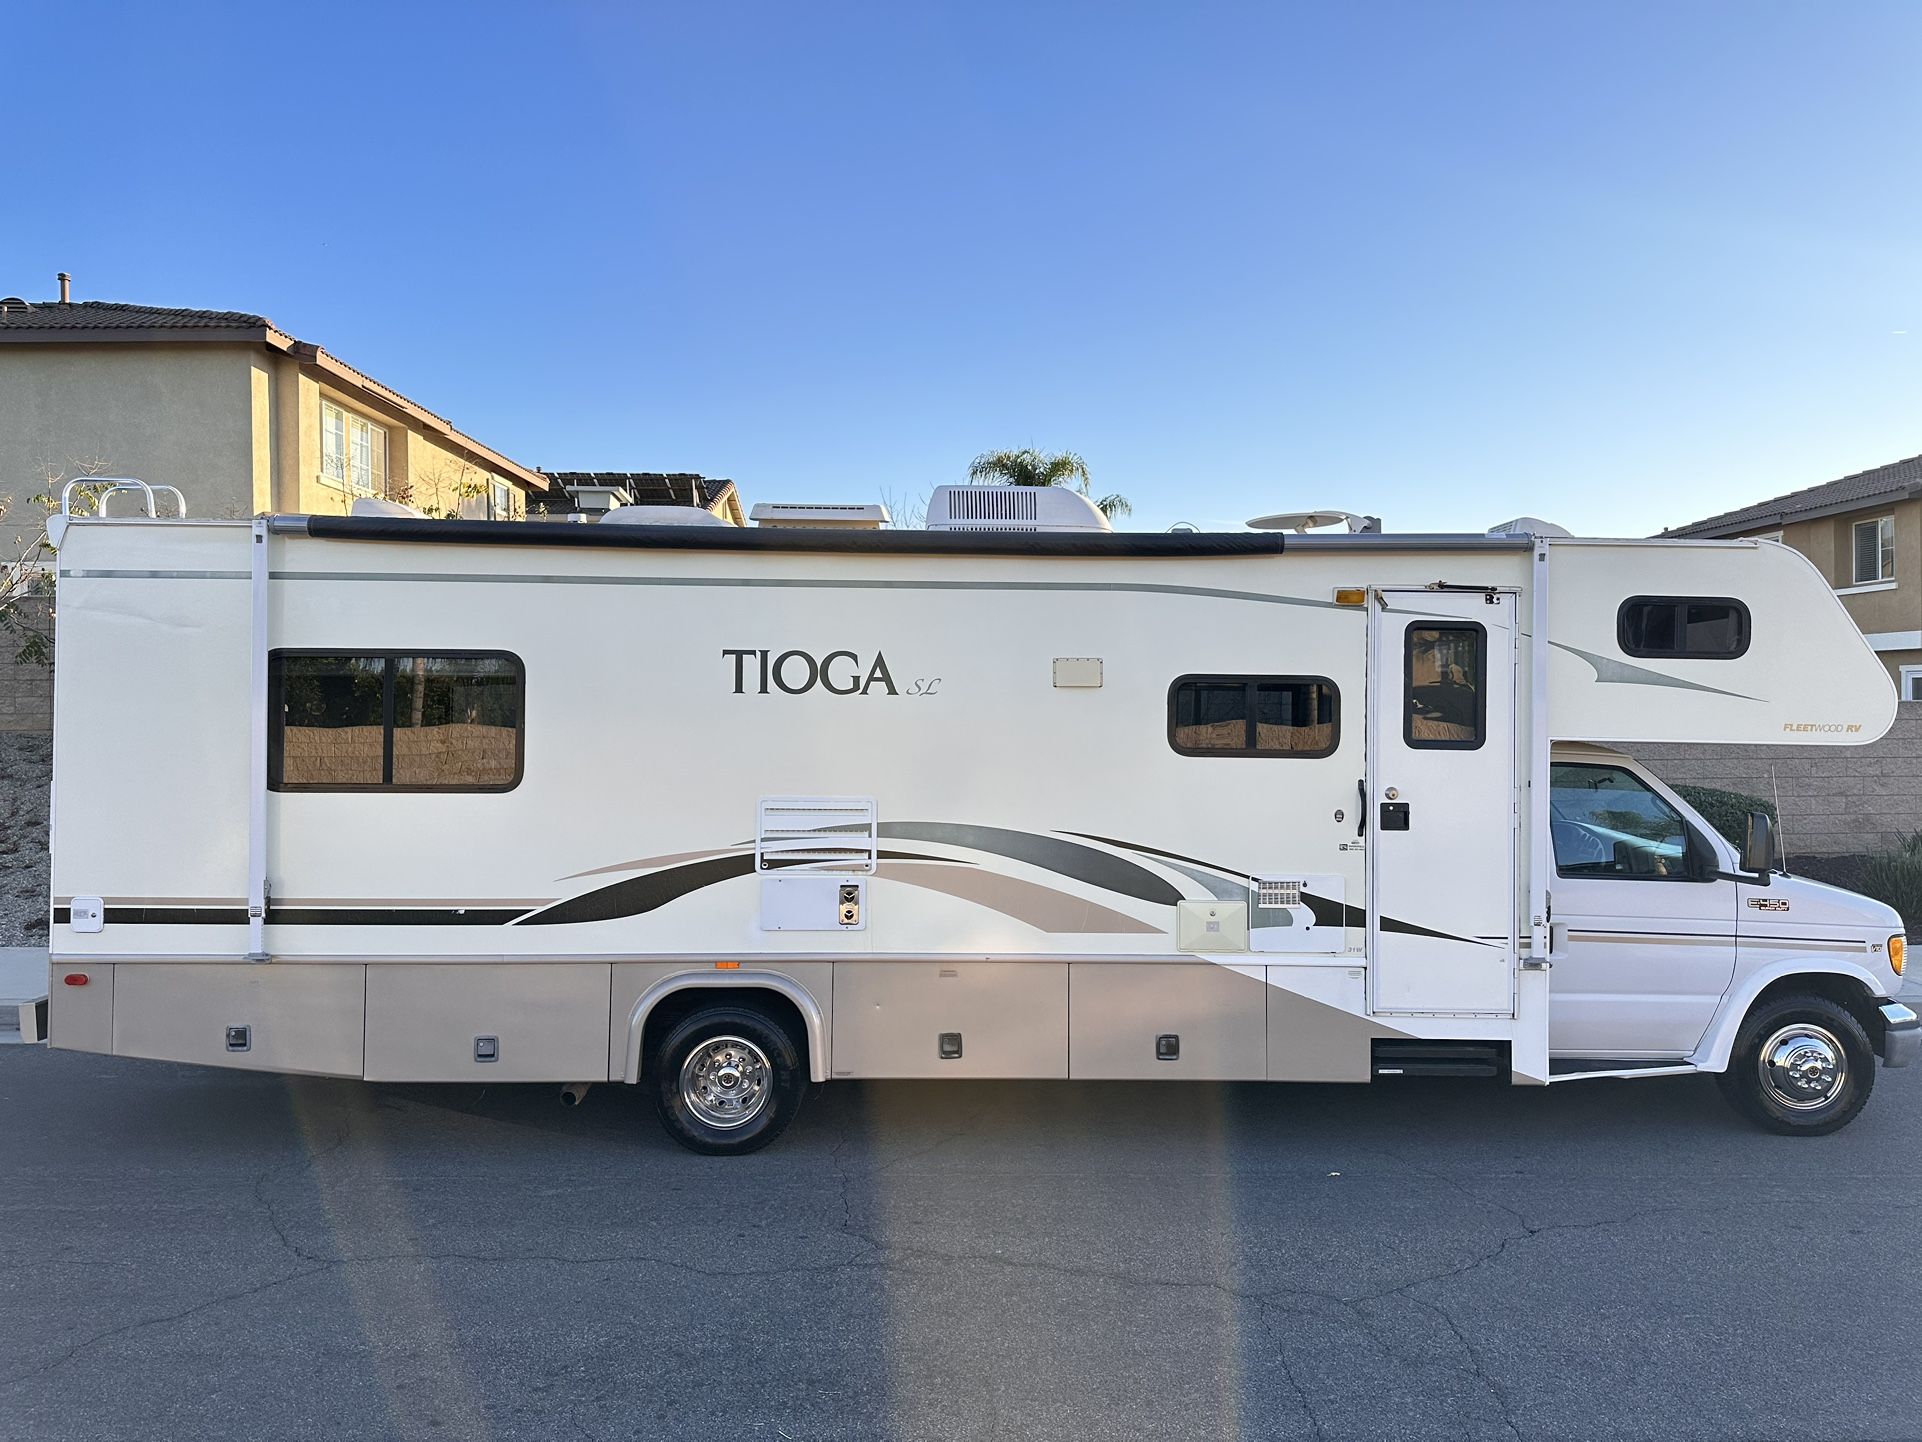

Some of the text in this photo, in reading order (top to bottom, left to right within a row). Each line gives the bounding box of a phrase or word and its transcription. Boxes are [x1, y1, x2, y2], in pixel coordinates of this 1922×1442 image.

[722, 649, 942, 697] TIOGA SL
[1783, 723, 1862, 733] FLEETWOOD RV
